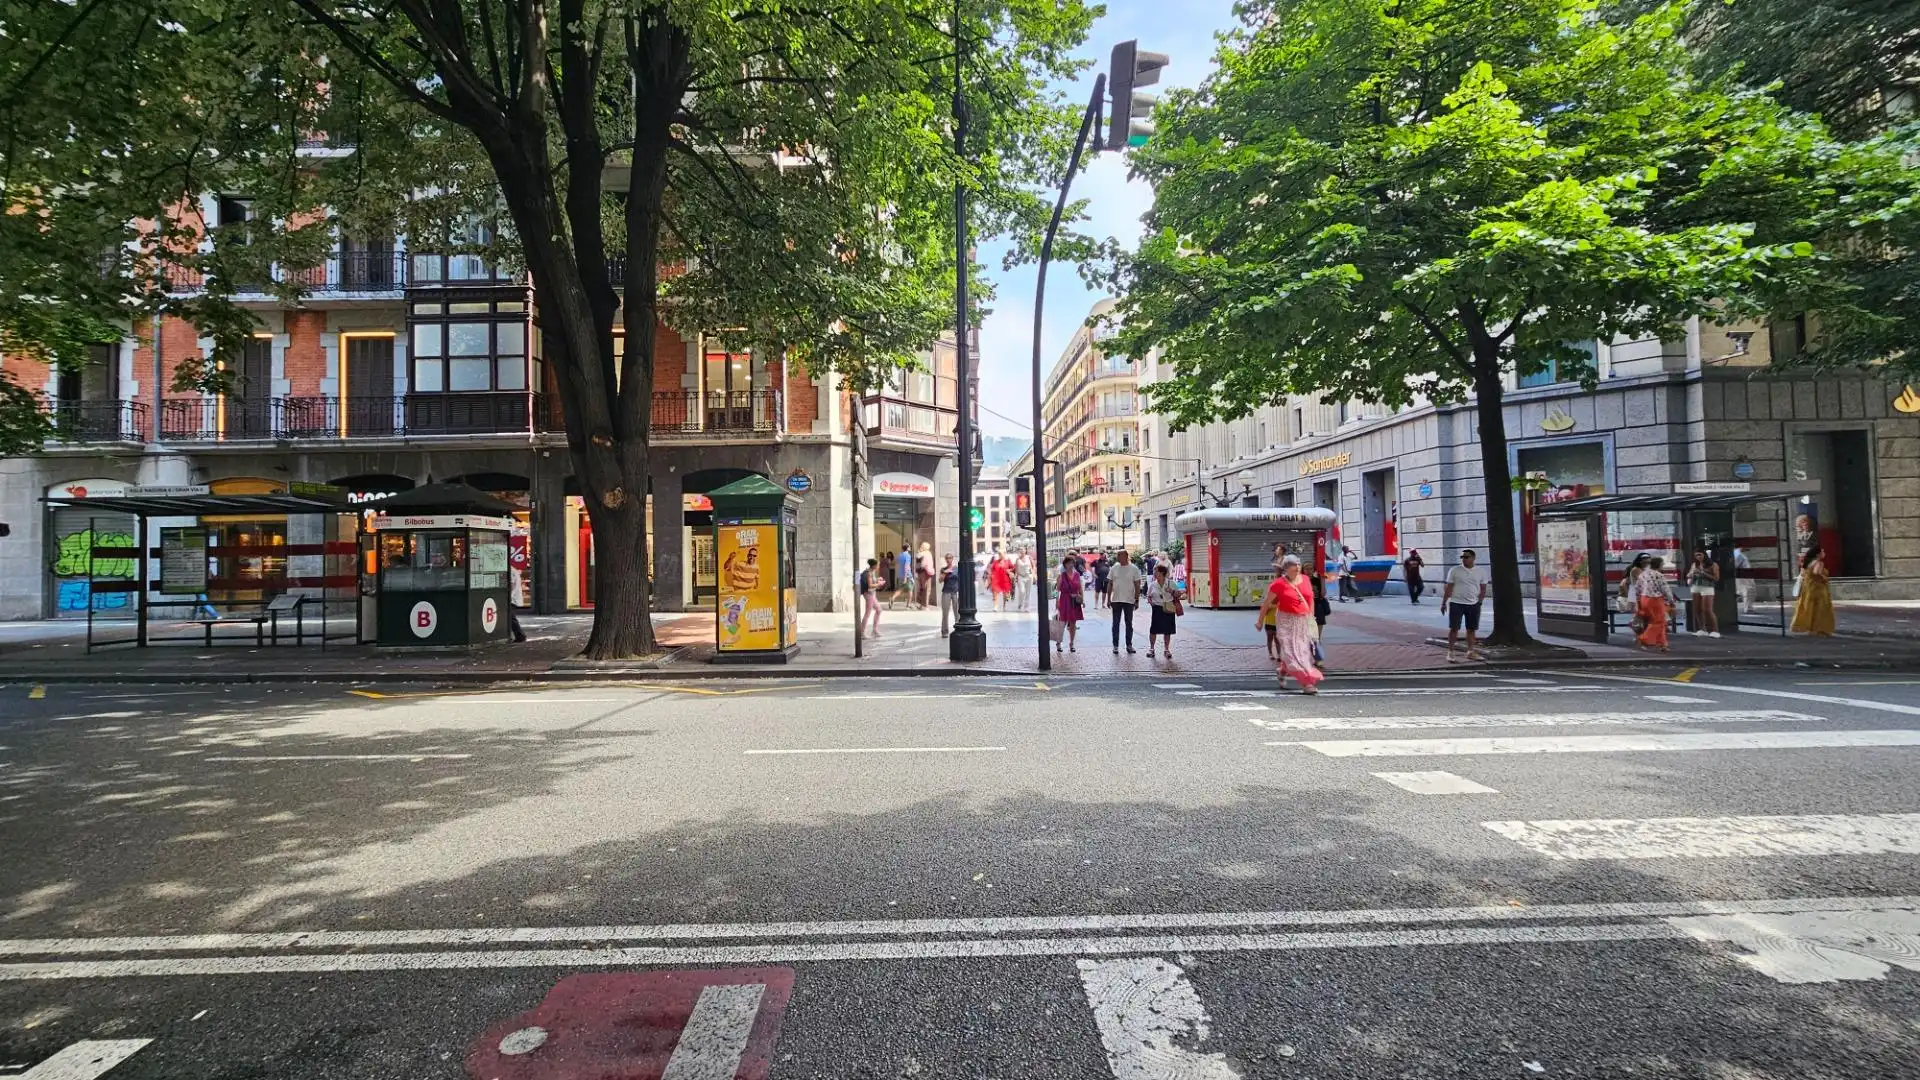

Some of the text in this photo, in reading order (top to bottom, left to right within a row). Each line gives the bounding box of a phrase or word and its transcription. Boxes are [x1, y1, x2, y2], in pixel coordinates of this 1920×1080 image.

[1308, 451, 1352, 472] Santander
[404, 518, 435, 526] Bilbobus
[417, 611, 431, 628] B
[486, 607, 495, 623] B
